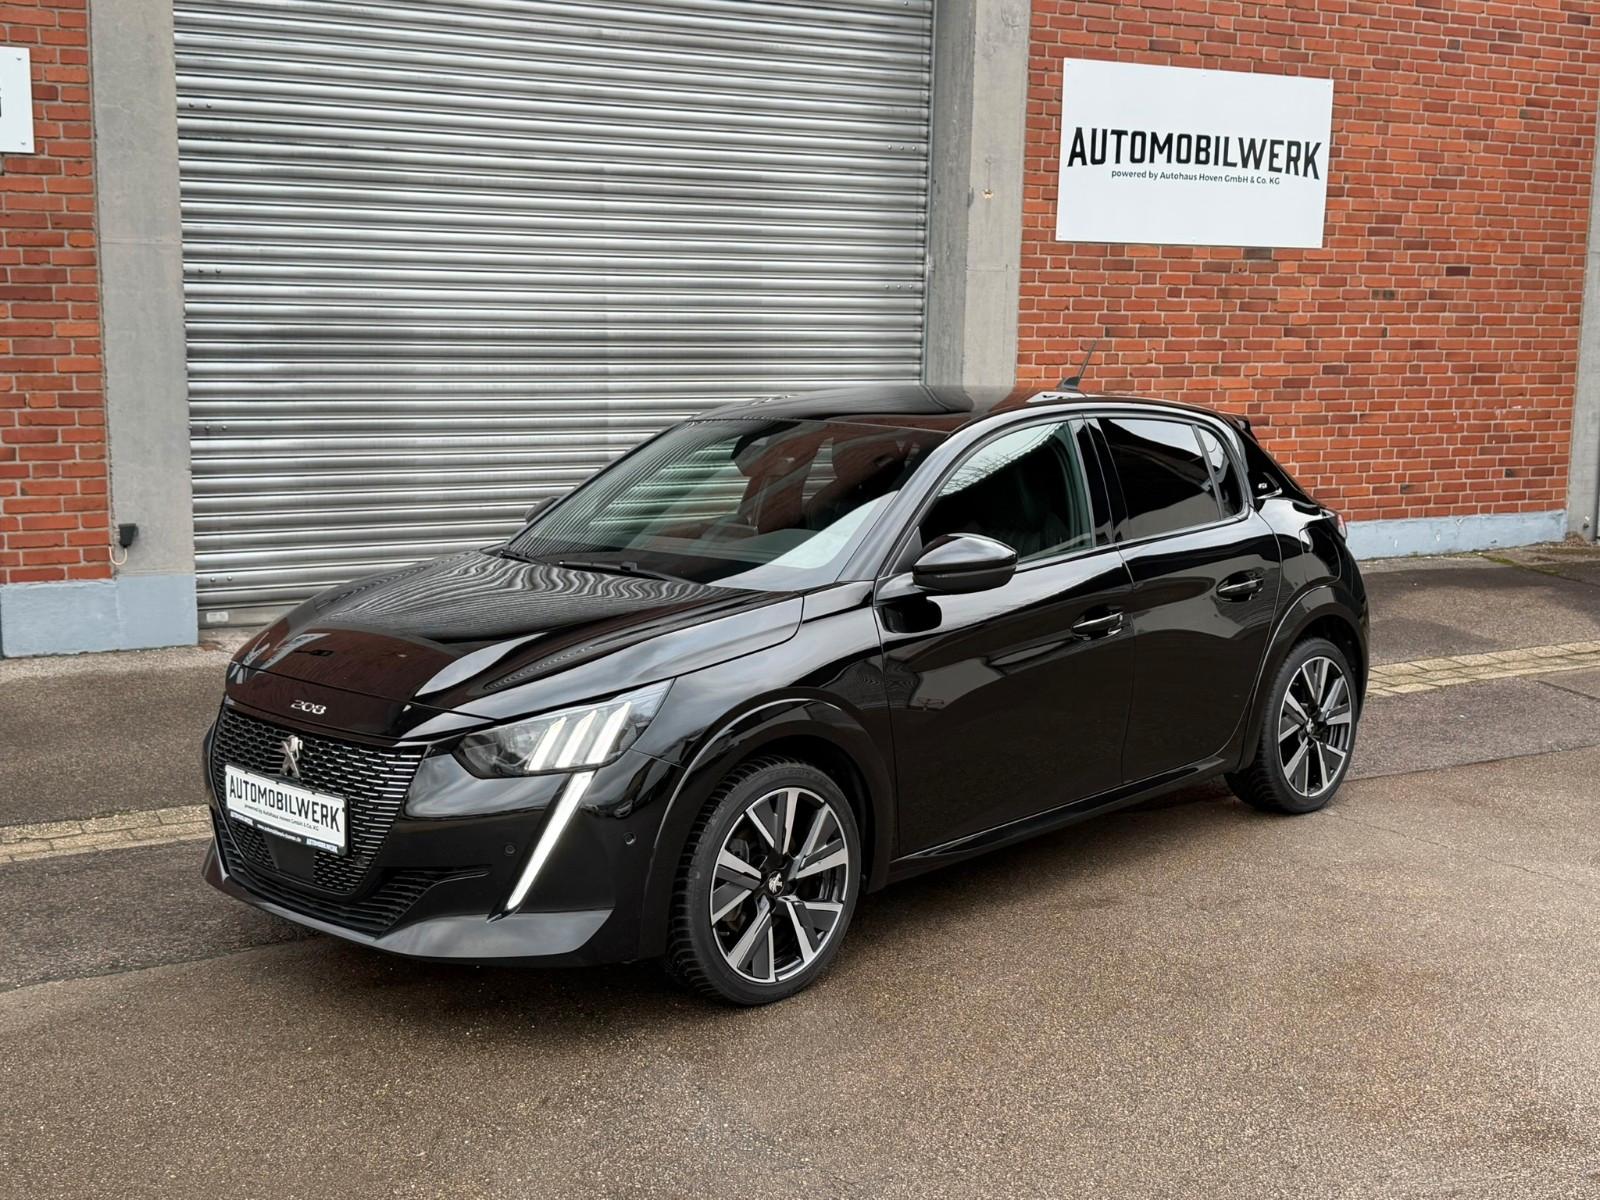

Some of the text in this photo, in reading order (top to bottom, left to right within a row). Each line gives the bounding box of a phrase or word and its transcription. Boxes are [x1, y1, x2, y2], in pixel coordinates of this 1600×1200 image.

[1067, 127, 1322, 180] AUTOMOBILWERK
[1111, 170, 1280, 185] powered by Autohaus Hoven GmbH & Co. KG
[290, 699, 327, 715] 208
[229, 774, 341, 833] AUTOMOBILWERK
